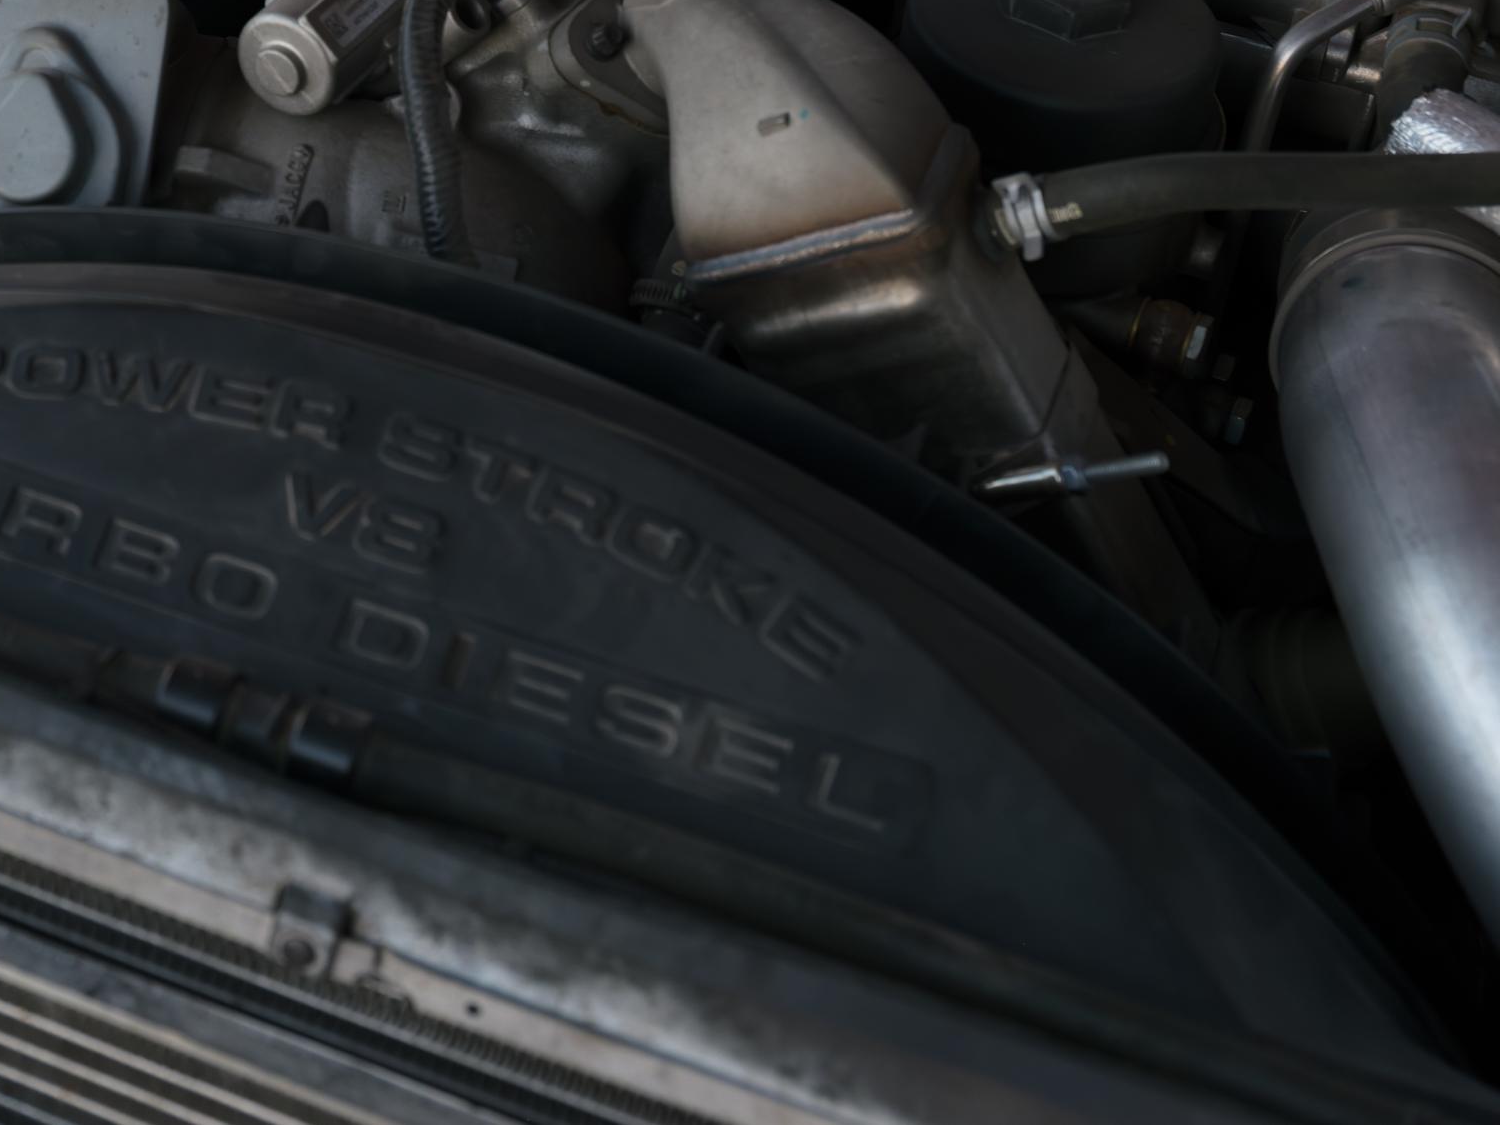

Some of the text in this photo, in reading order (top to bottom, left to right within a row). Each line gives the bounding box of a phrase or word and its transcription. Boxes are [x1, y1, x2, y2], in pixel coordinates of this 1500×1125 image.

[283, 463, 447, 577] V8
[376, 410, 863, 687] STROKE
[338, 596, 886, 833] DIESEL
